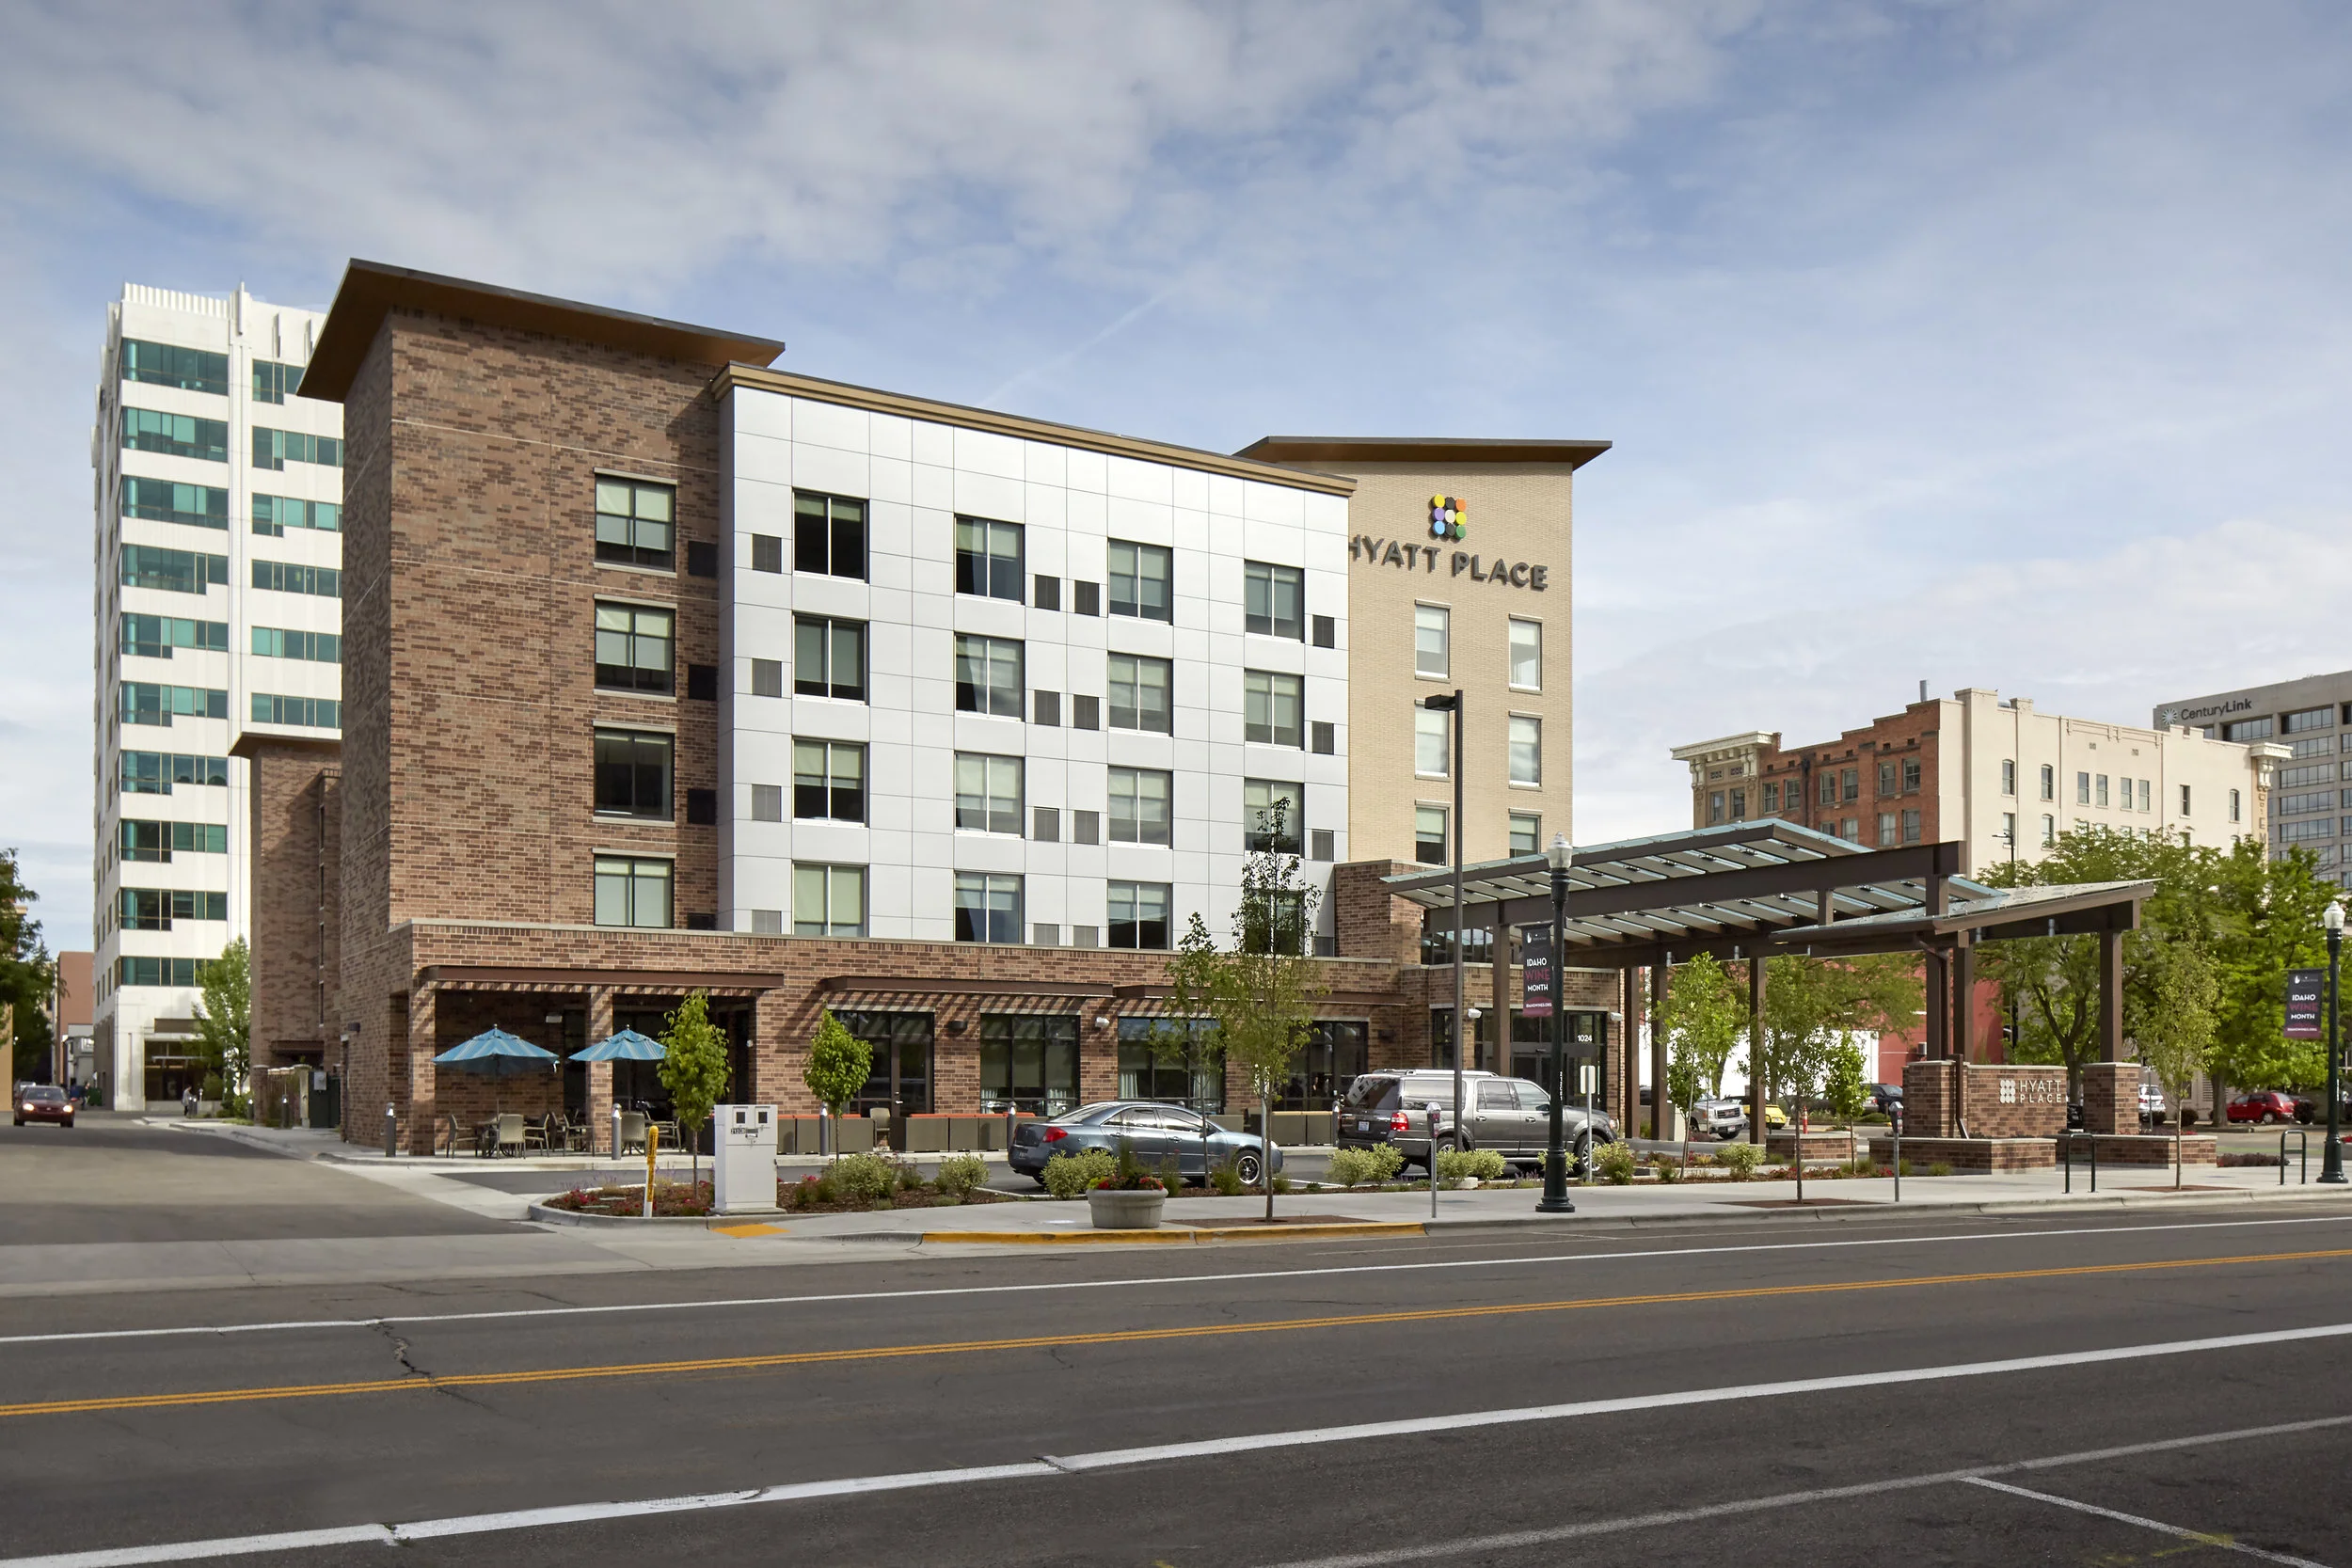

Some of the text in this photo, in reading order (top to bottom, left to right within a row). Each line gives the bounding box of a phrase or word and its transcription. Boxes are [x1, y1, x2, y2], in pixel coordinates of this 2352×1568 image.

[1349, 534, 1548, 590] HYATT PLACE
[2181, 698, 2252, 721] CenturyLink
[1526, 958, 1548, 967] IDAHO
[1525, 968, 1550, 981] WINE
[1527, 984, 1549, 992] MONTH
[2290, 1002, 2318, 1012] WINE
[2020, 1080, 2061, 1092] HYATT
[2020, 1094, 2061, 1103] PLACE
